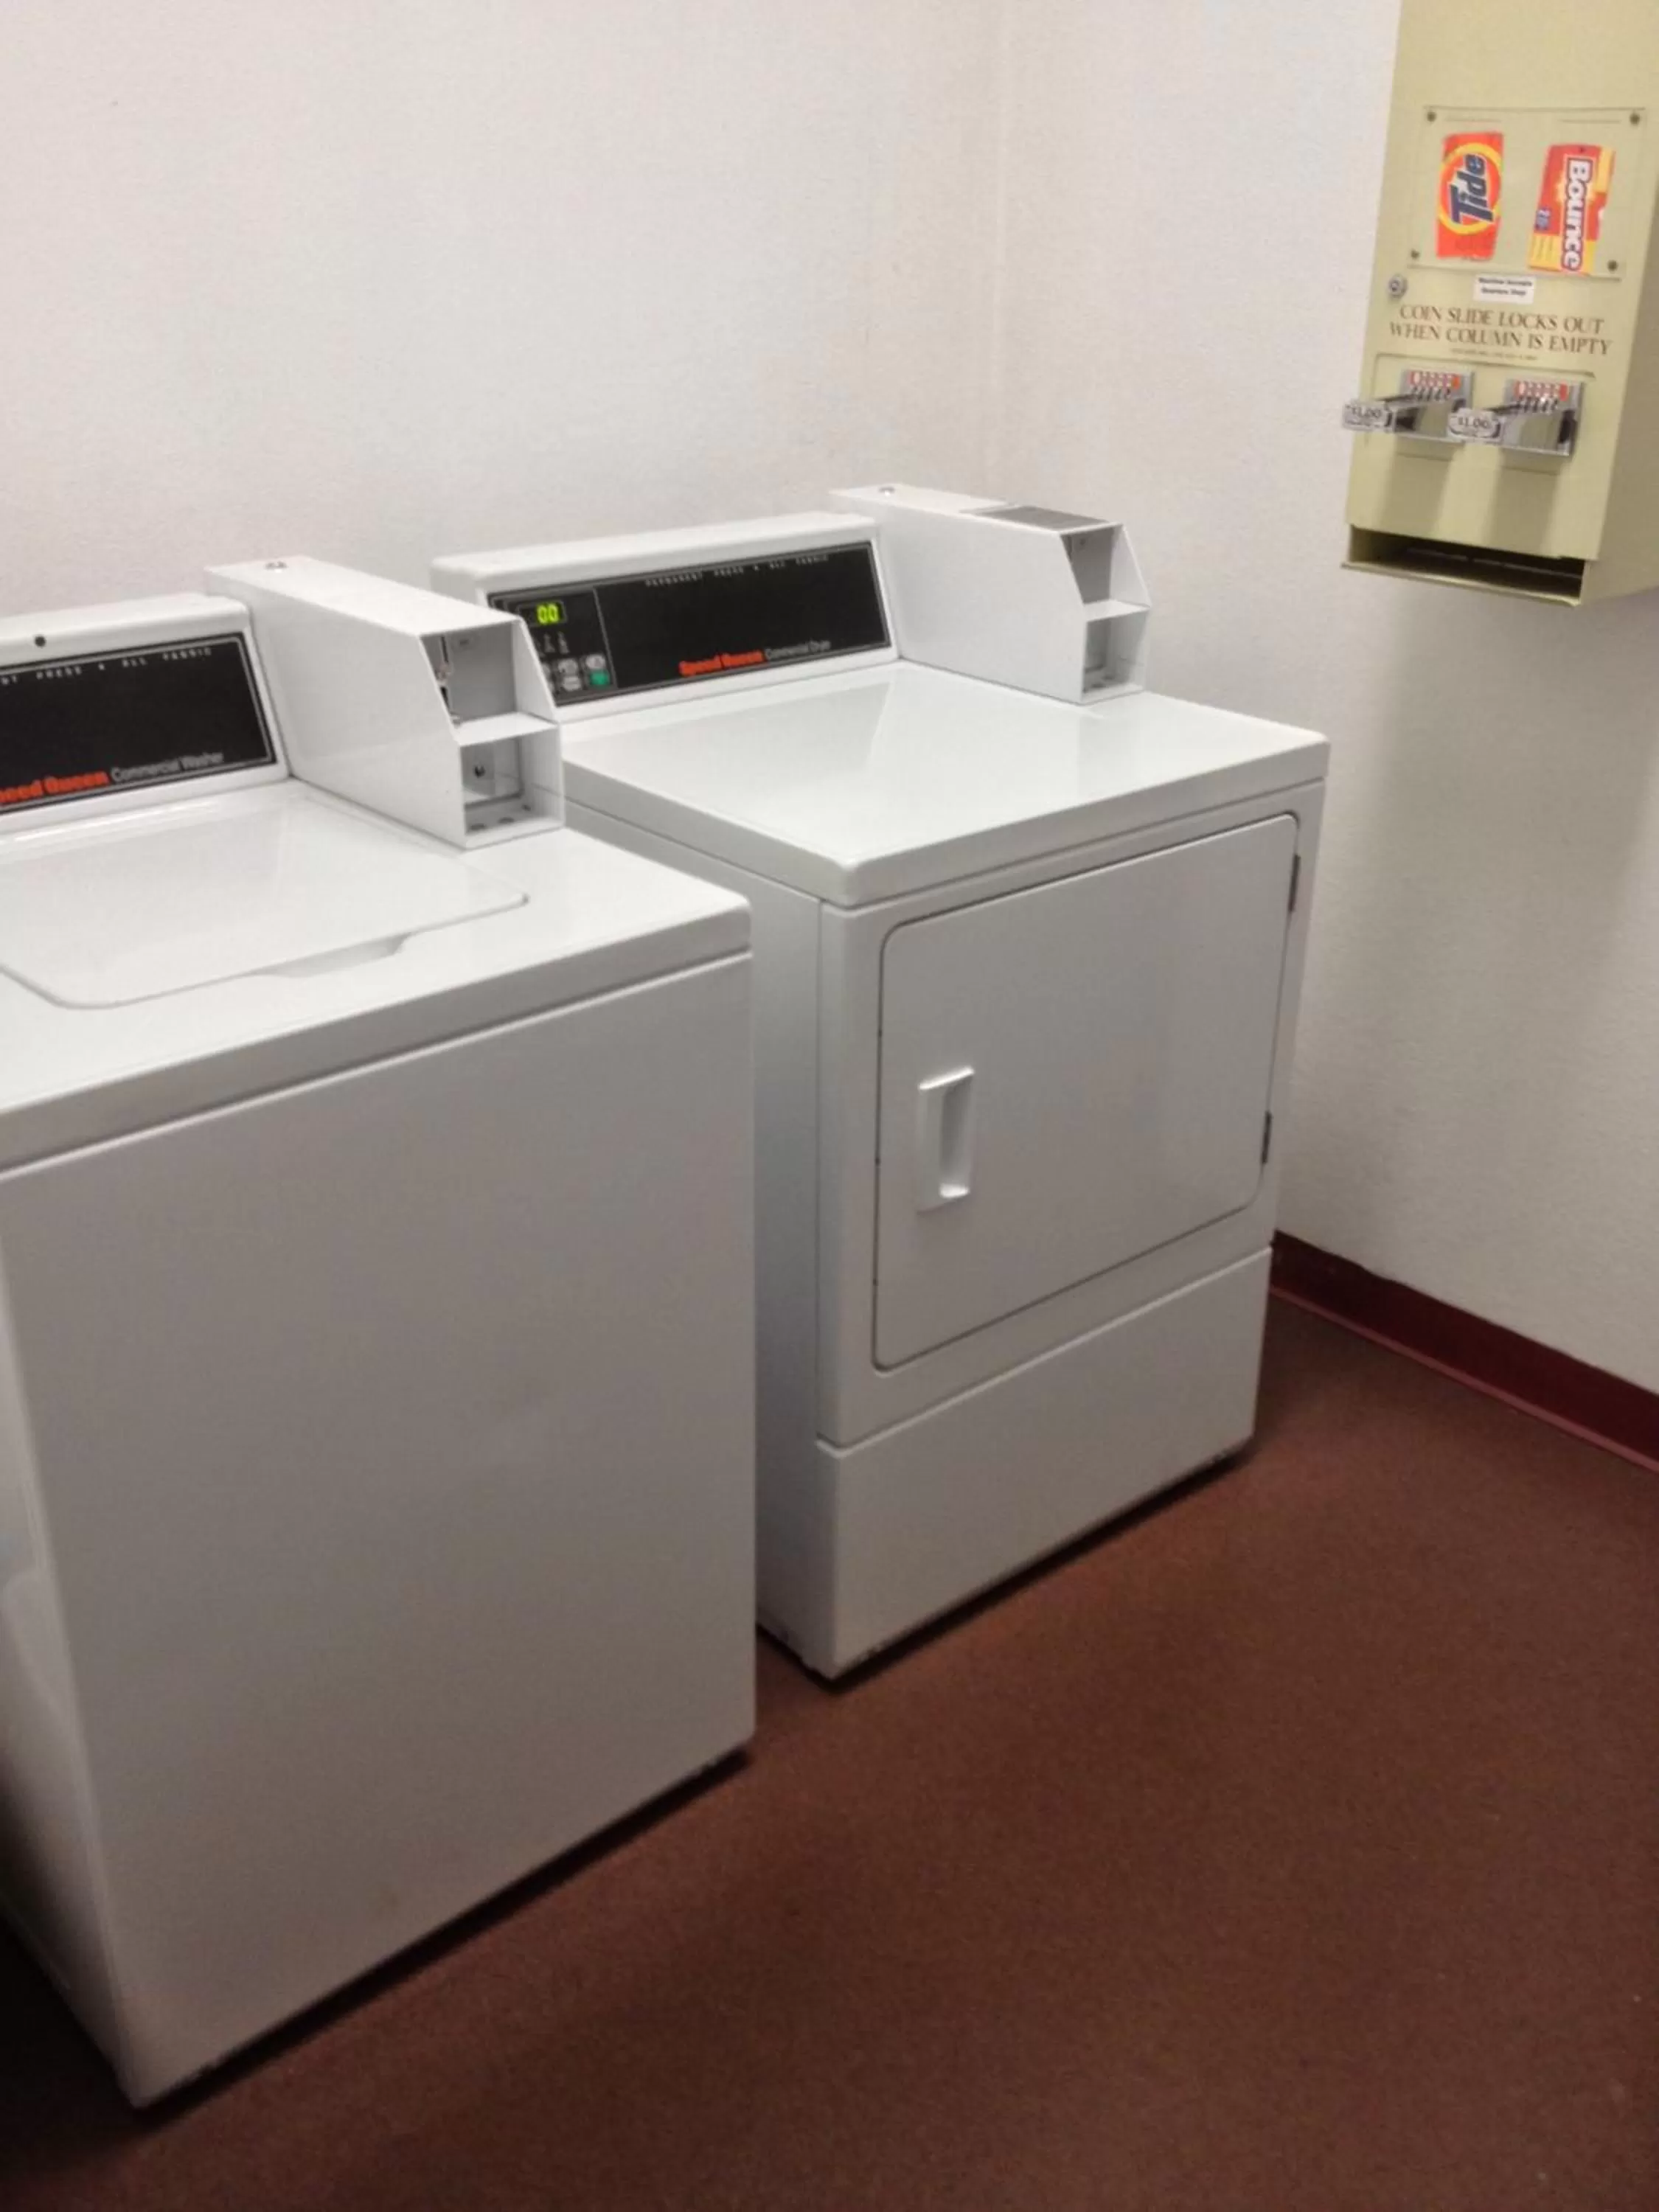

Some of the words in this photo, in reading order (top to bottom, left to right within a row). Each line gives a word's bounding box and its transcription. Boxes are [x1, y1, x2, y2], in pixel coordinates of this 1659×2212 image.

[1449, 153, 1494, 224] Tide
[1562, 157, 1593, 271] Bounce
[1400, 305, 1441, 321] COIN
[1447, 307, 1494, 324] SLIDE
[1498, 311, 1558, 331] LOCKS
[1563, 316, 1605, 335] OUT
[1389, 321, 1441, 341] WHEN
[1445, 326, 1522, 348] COLUMN
[1528, 333, 1543, 349] IS
[1548, 334, 1613, 355] EMPTY
[537, 602, 560, 625] 00
[111, 757, 181, 782] Commercial
